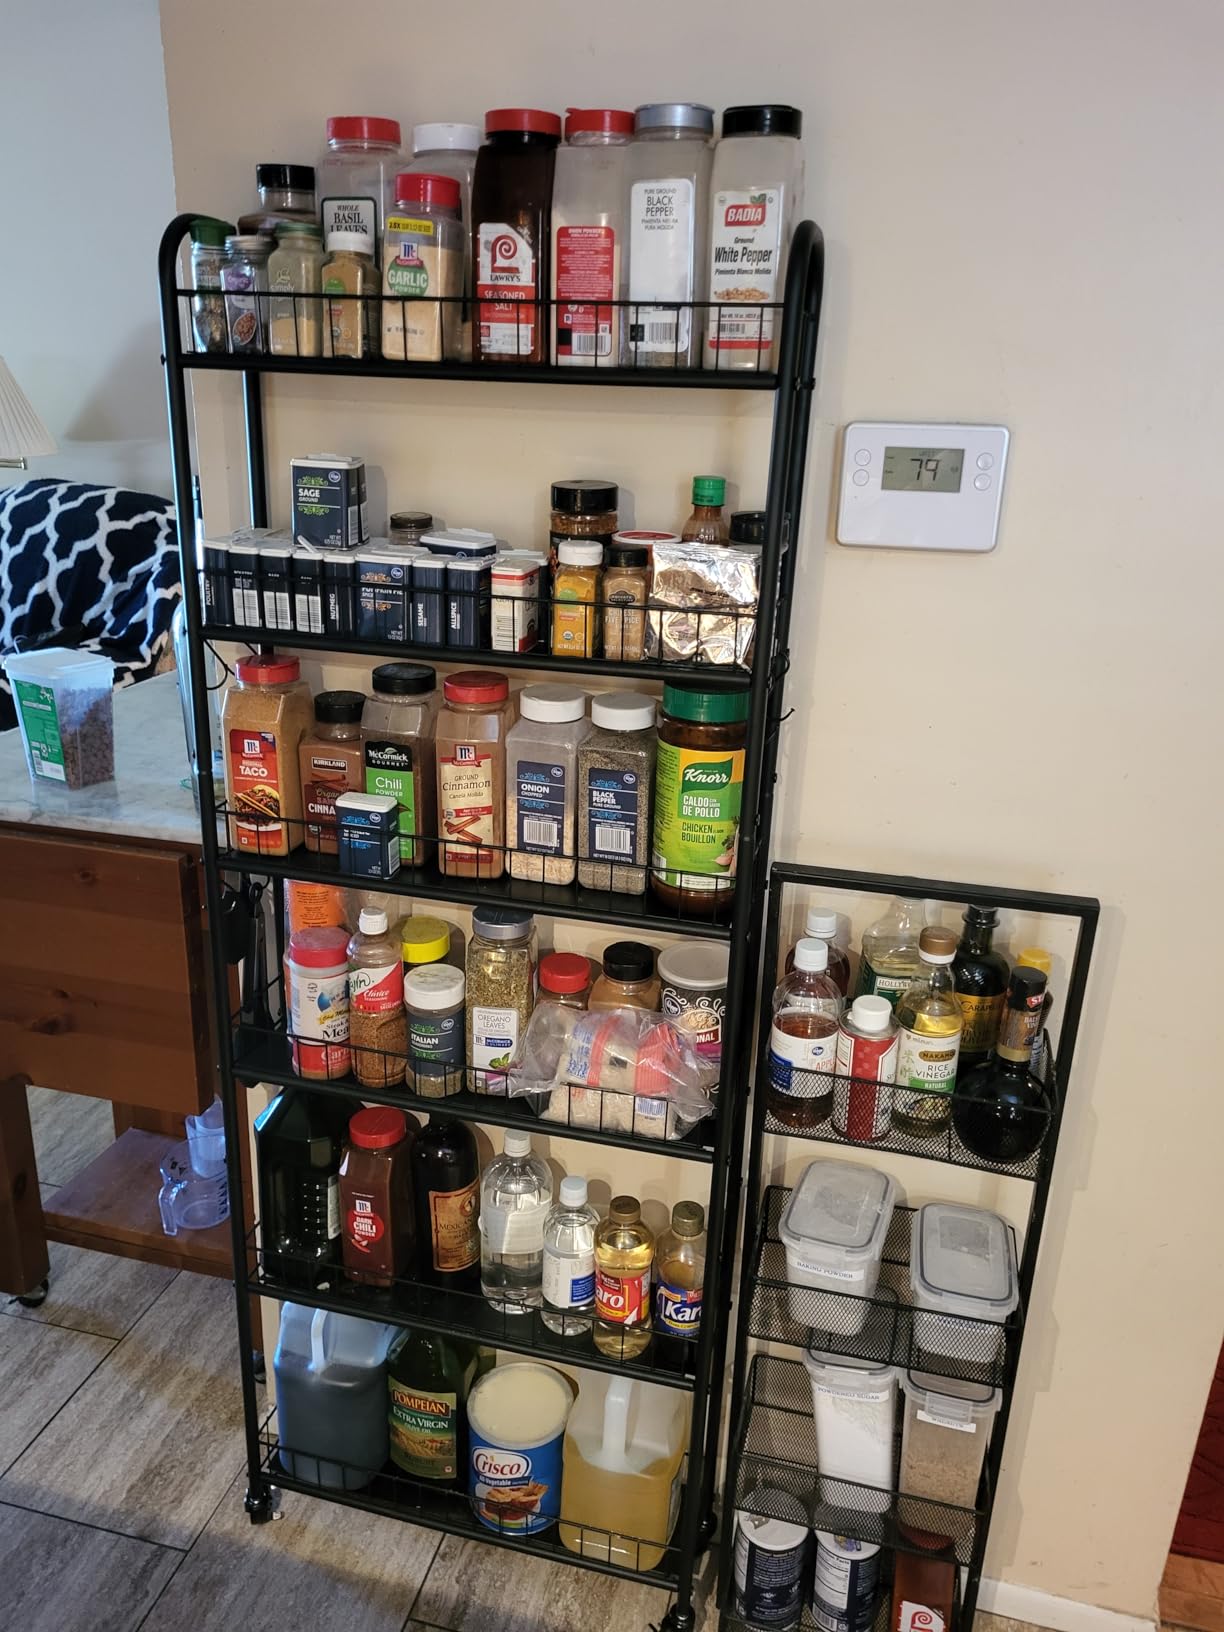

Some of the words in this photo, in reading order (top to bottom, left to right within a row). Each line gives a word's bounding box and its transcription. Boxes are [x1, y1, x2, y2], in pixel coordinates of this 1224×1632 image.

[647, 195, 672, 206] BLACK
[337, 204, 359, 212] WHOLE
[646, 207, 673, 217] PEPPER
[334, 213, 363, 224] BASIL
[727, 206, 763, 223] BADIA
[331, 225, 367, 235] LEAVES
[714, 247, 738, 263] White
[741, 247, 773, 266] Pepper
[388, 270, 428, 288] GARLIC
[490, 273, 521, 283] LAWRY'S
[484, 291, 526, 300] SEASONED
[495, 302, 513, 311] SALT
[910, 458, 940, 481] 79
[298, 488, 321, 498] SAGE
[330, 593, 338, 620] NUTMEG
[368, 750, 408, 765] McCormick
[313, 759, 346, 768] KIRKLAND
[239, 765, 268, 777] TACO
[684, 769, 730, 784] Knorr
[455, 774, 479, 782] GROUND
[376, 777, 402, 793] Chili
[443, 779, 491, 792] Cinnamon
[520, 783, 550, 794] ONION
[376, 790, 403, 798] POWDER
[592, 790, 615, 799] BLACK
[592, 797, 617, 805] PEPPER
[683, 795, 709, 808] CALDO
[308, 803, 336, 815] CINNA
[682, 806, 695, 817] DE
[696, 807, 721, 818] POLLO
[682, 822, 713, 835] CHICKEN
[682, 832, 717, 844] BOUILLON
[878, 979, 911, 988] HOLLYW
[364, 990, 389, 998] Clásico
[478, 1014, 511, 1024] OREGANO
[326, 1020, 345, 1031] Steak
[483, 1022, 506, 1031] LEAVES
[322, 1025, 350, 1040] Mea
[411, 1033, 439, 1045] ITALIAN
[816, 1056, 836, 1071] APPL
[927, 1064, 949, 1072] RICE
[916, 1069, 955, 1079] VINEGAR
[356, 1216, 372, 1224] DARK
[353, 1221, 376, 1233] CHILI
[355, 1230, 376, 1238] POWDER
[797, 1261, 822, 1272] BAKING
[596, 1286, 624, 1308] aro
[665, 1300, 702, 1321] Kar
[816, 1386, 856, 1398] POWDERED
[857, 1391, 880, 1400] SUGAR
[394, 1391, 446, 1414] POMPEIAN
[393, 1405, 417, 1426] EXTRA
[418, 1417, 449, 1429] VIRGIN
[475, 1453, 521, 1476] Crisco
[486, 1477, 511, 1486] Vegetable
